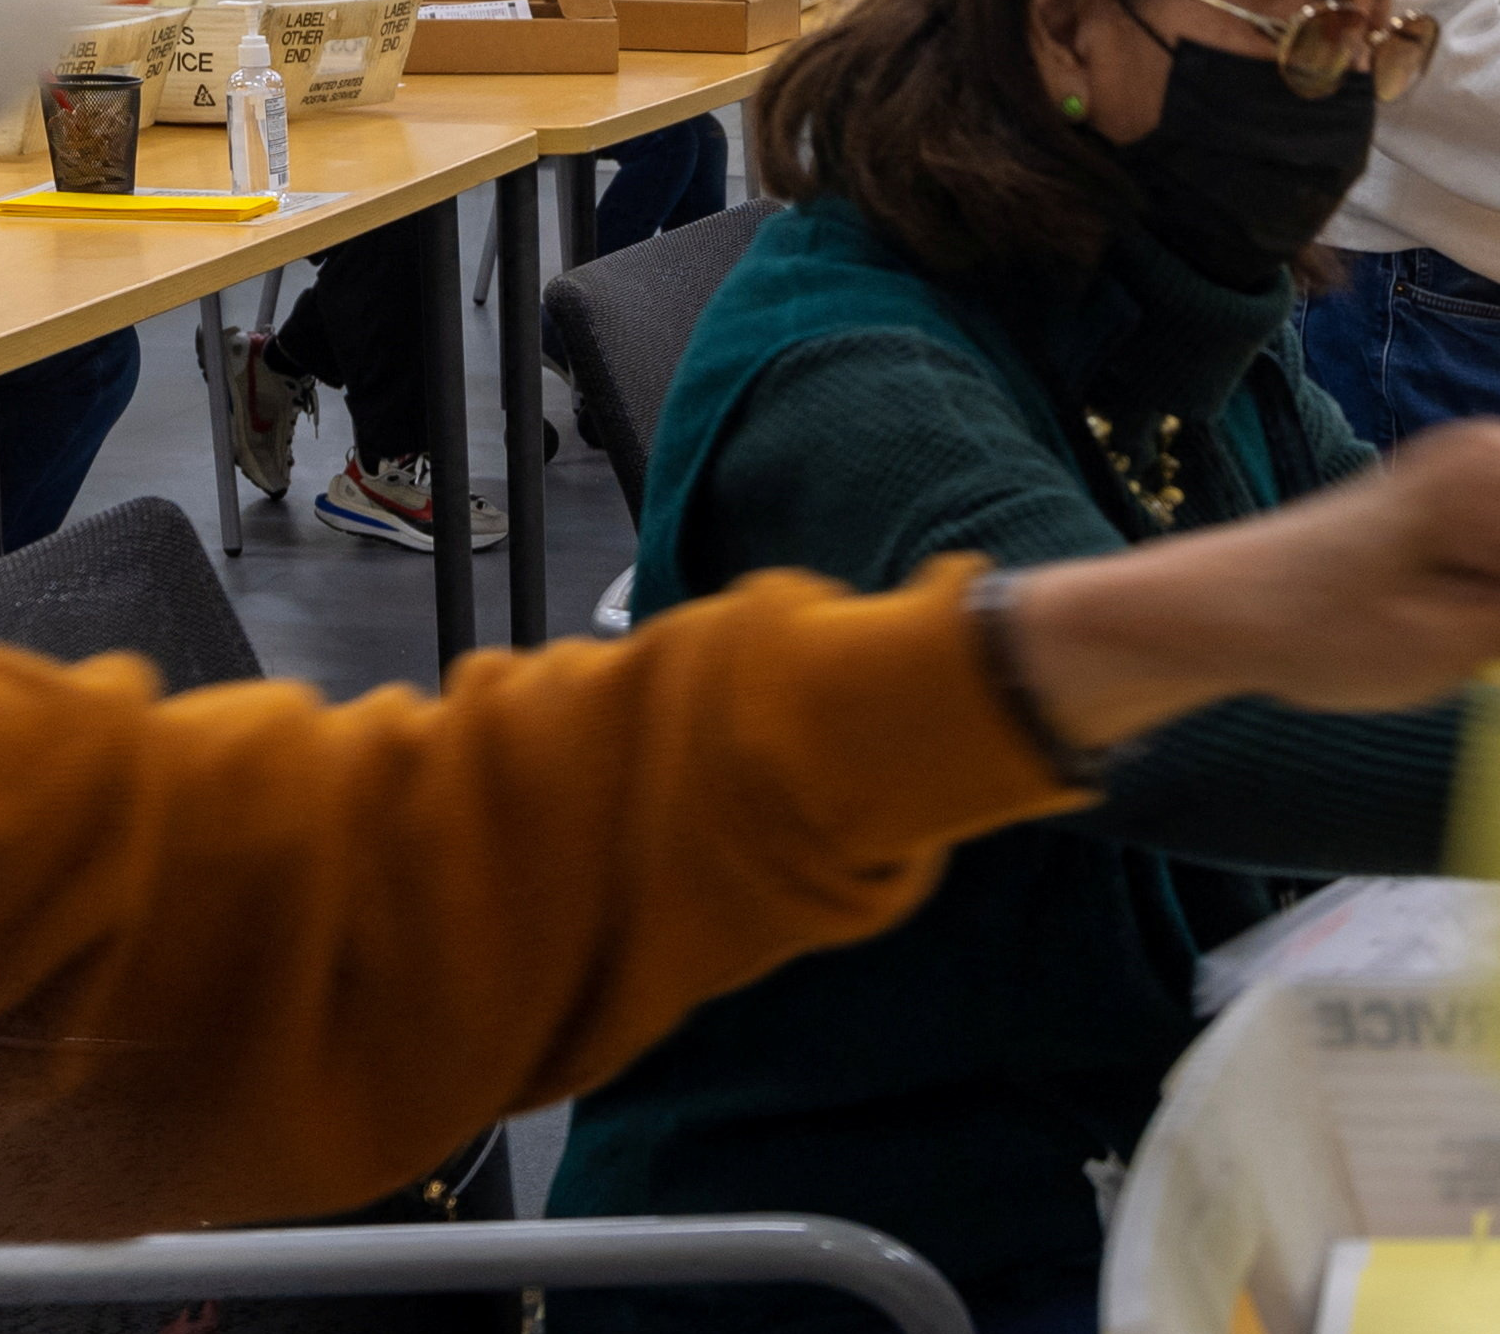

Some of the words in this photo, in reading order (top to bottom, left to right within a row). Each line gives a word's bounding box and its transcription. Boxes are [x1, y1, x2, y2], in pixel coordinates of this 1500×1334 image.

[384, 1, 411, 20] LABEL
[286, 12, 325, 28] LABEL
[380, 18, 410, 36] OTHER
[281, 30, 323, 46] OTHER
[380, 36, 400, 53] END
[146, 41, 174, 63] OTHER
[284, 48, 311, 63] END
[145, 61, 163, 79] END
[309, 79, 336, 92] UNITED
[337, 77, 364, 89] STATES
[301, 92, 328, 105] POSTAL
[334, 89, 361, 102] SERVICE
